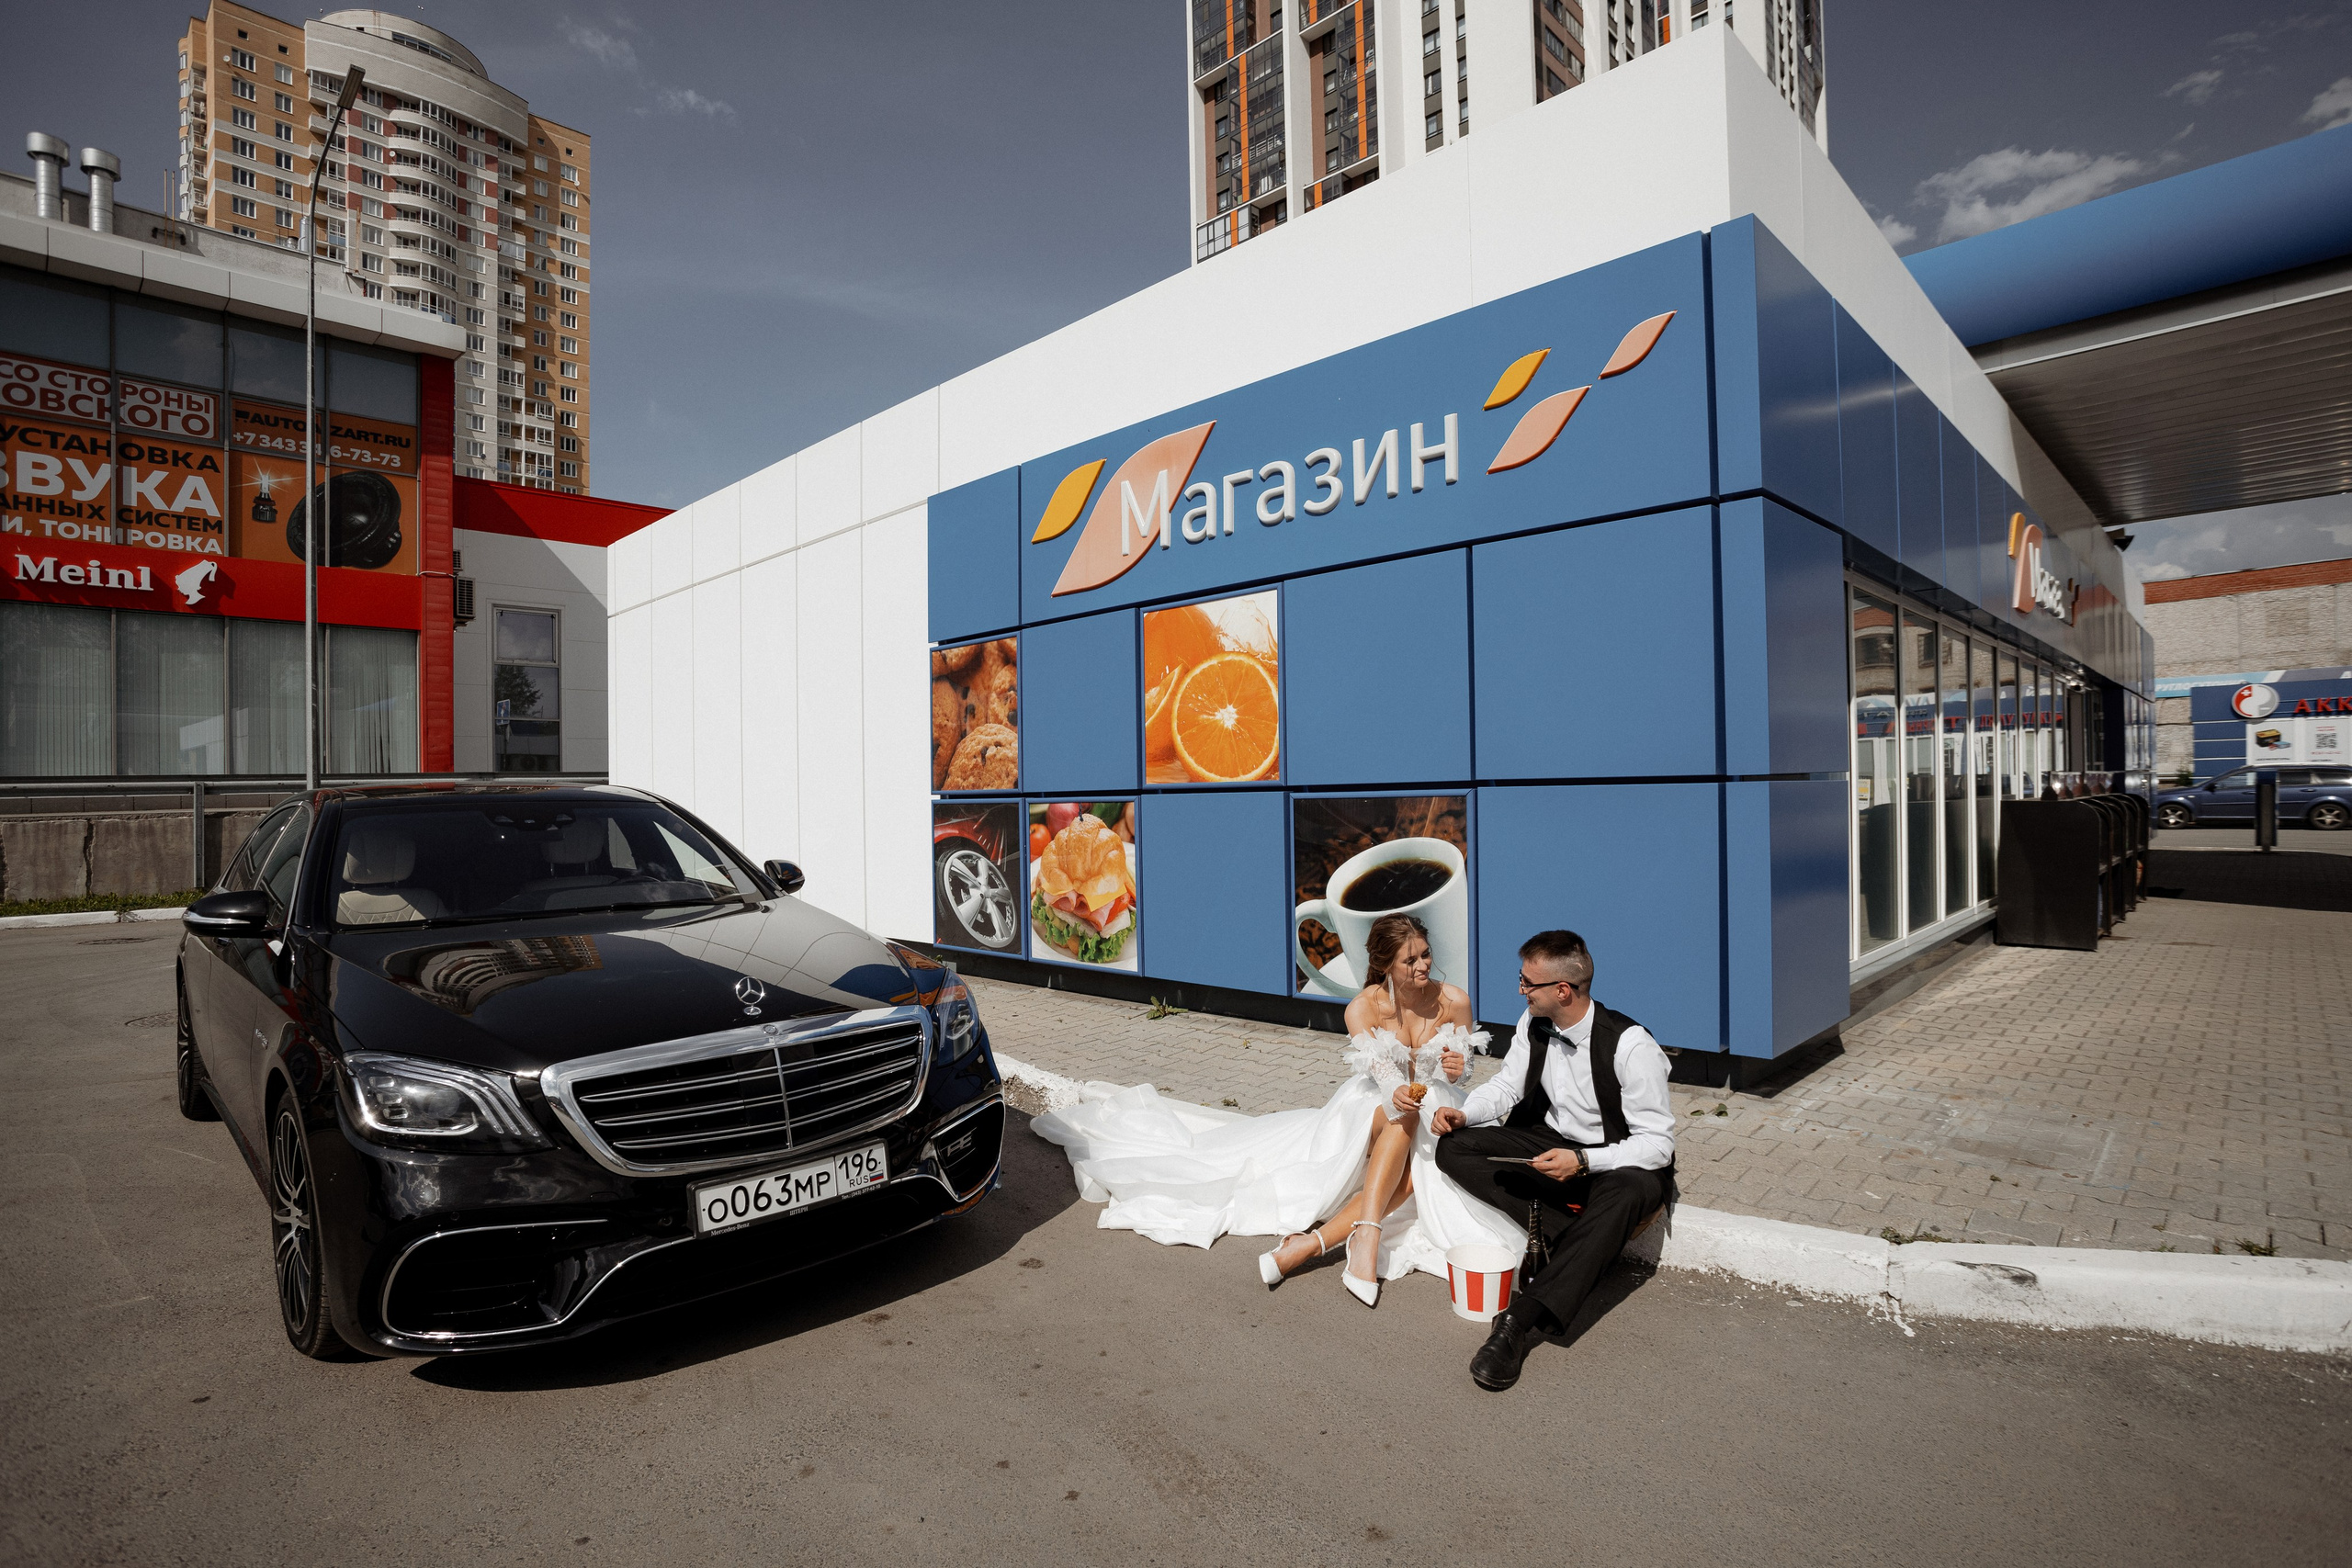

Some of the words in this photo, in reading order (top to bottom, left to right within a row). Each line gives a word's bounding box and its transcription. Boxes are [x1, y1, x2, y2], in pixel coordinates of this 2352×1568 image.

[48, 370, 210, 414] СТОРОНЫ
[0, 424, 221, 473] УСТАНОВКА
[259, 434, 297, 452] 343
[0, 448, 221, 518] ВУКА
[1120, 412, 1459, 556] Магазин
[40, 518, 223, 555] ТОНИРОВКА
[118, 507, 223, 535] СИСТЕМ
[15, 554, 154, 592] Meinl
[838, 1148, 878, 1179] 196
[849, 1175, 870, 1188] RUS
[710, 1222, 750, 1236] Mercedes-Benz
